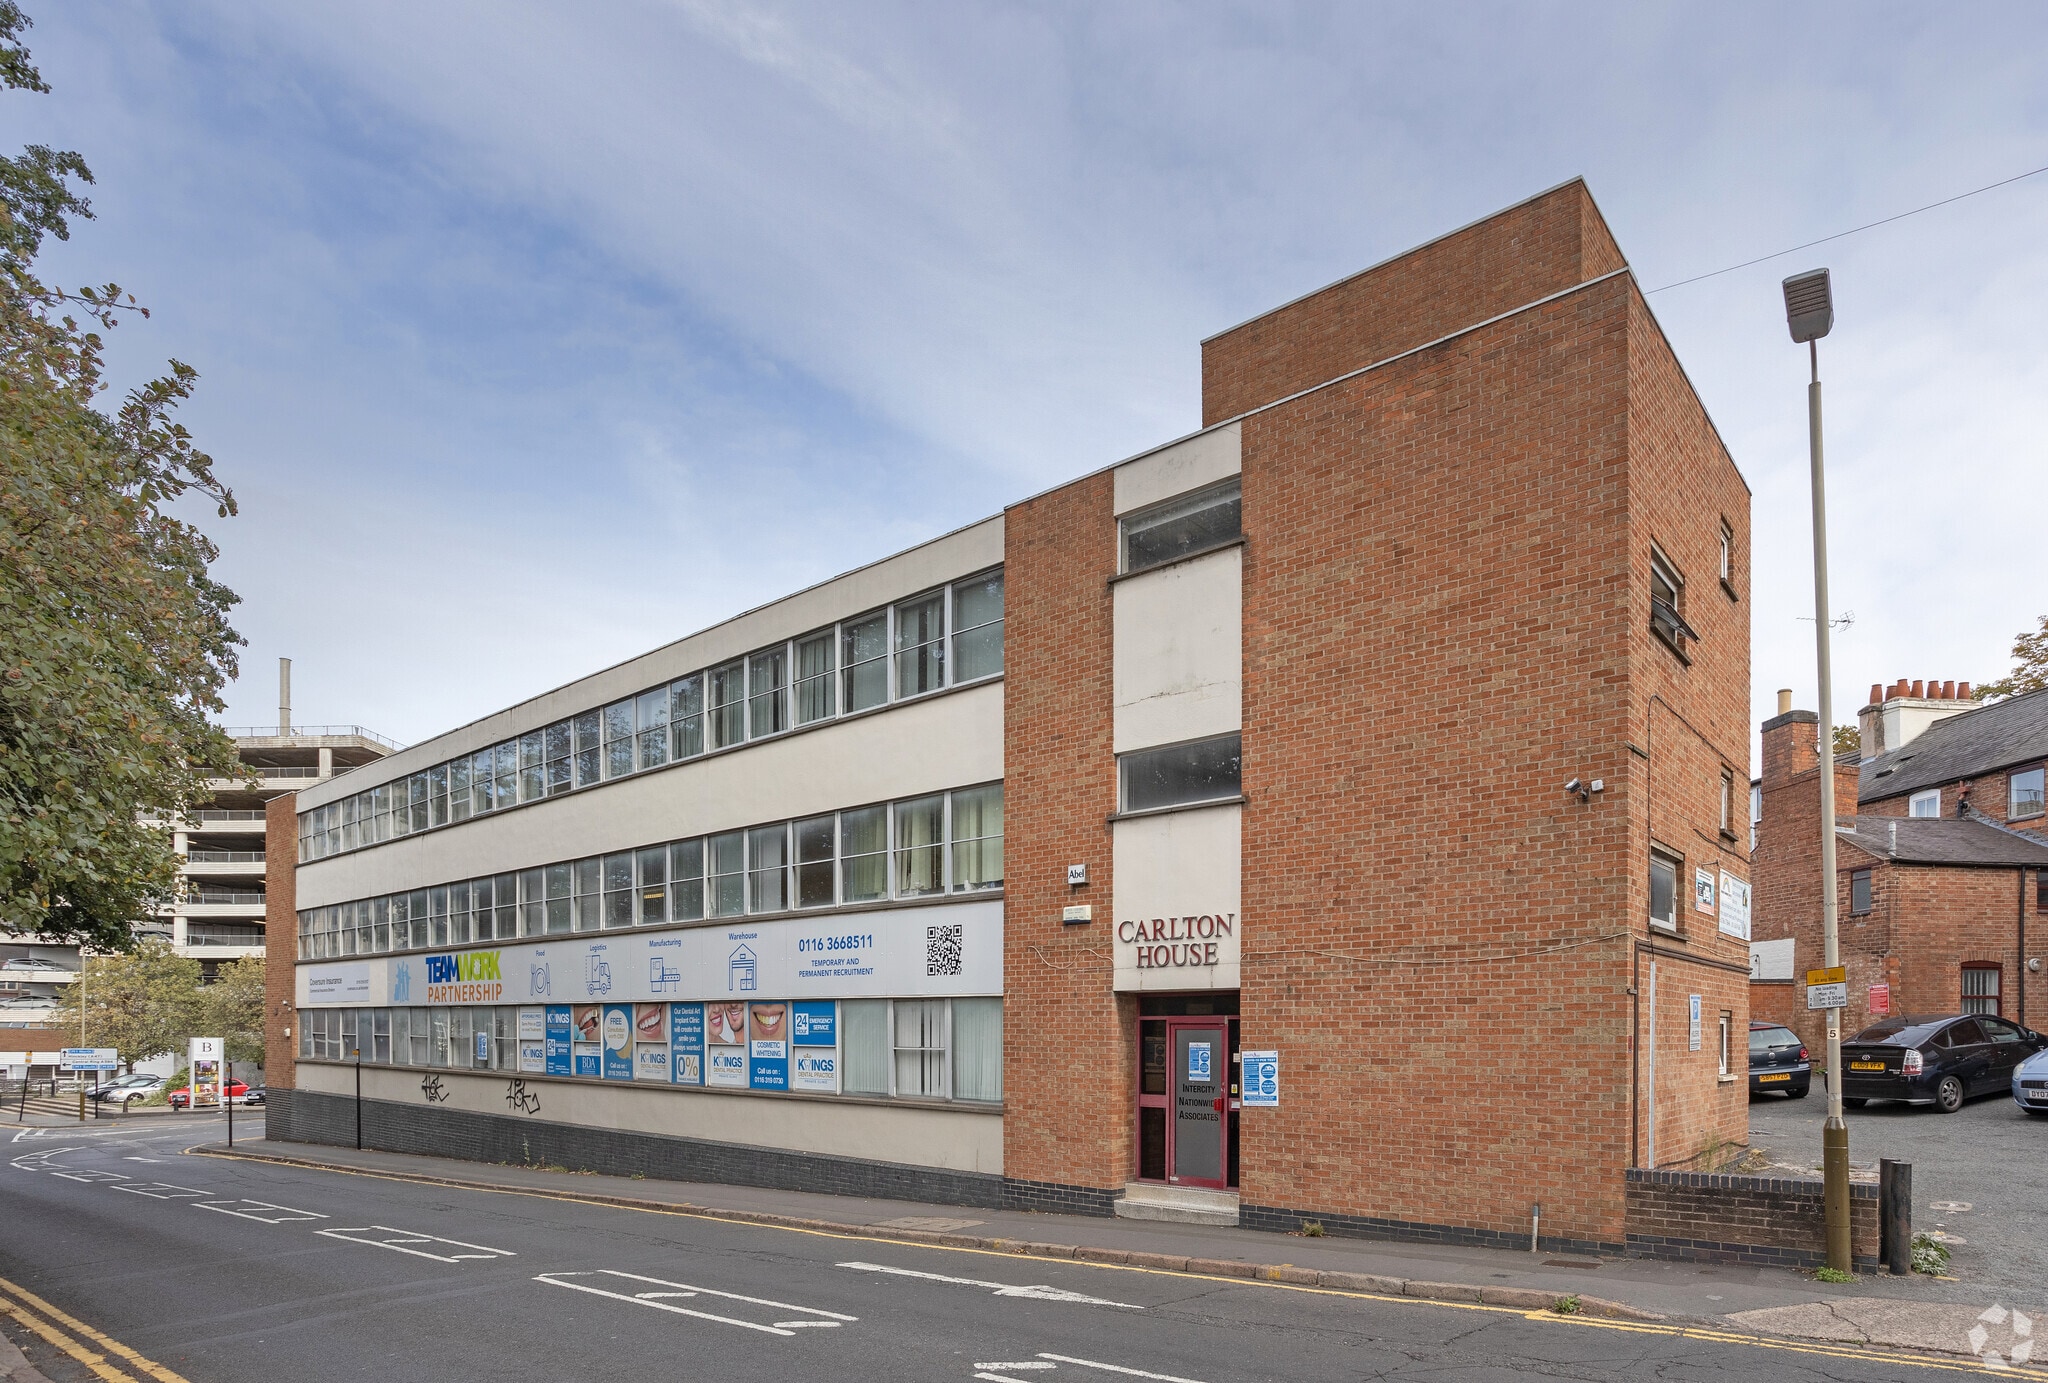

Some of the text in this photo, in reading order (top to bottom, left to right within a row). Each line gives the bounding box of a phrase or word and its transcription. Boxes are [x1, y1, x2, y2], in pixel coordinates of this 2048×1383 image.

[1069, 869, 1085, 879] Abel
[1118, 914, 1235, 943] CARLTON
[728, 932, 758, 941] Warehouse
[589, 944, 607, 952] Logistics
[649, 938, 682, 948] Manufacturing
[798, 934, 873, 952] 0116 3668511
[1136, 942, 1219, 968] HOUSE
[811, 957, 860, 967] TEMPORARY AND
[426, 952, 502, 984] TEAMWORK
[798, 967, 874, 978] PERMANENT RECRUITMENT
[310, 977, 342, 986] Coversure Insurance
[428, 983, 502, 1002] PARTNERSHIP
[547, 1014, 570, 1023] KINGS
[610, 1017, 622, 1025] FREE
[796, 1015, 807, 1028] 24
[1829, 1029, 1836, 1038] 5
[202, 1042, 212, 1052] B
[548, 1040, 555, 1050] 24
[523, 1049, 543, 1058] KINGS
[641, 1053, 666, 1064] KINGS
[582, 1057, 596, 1069] BDA
[678, 1056, 698, 1077] 0%
[713, 1056, 743, 1067] KINGS
[798, 1059, 834, 1072] KINGS
[1182, 1084, 1216, 1094] INTERCITY
[1179, 1111, 1219, 1122] ASSOCIATES
